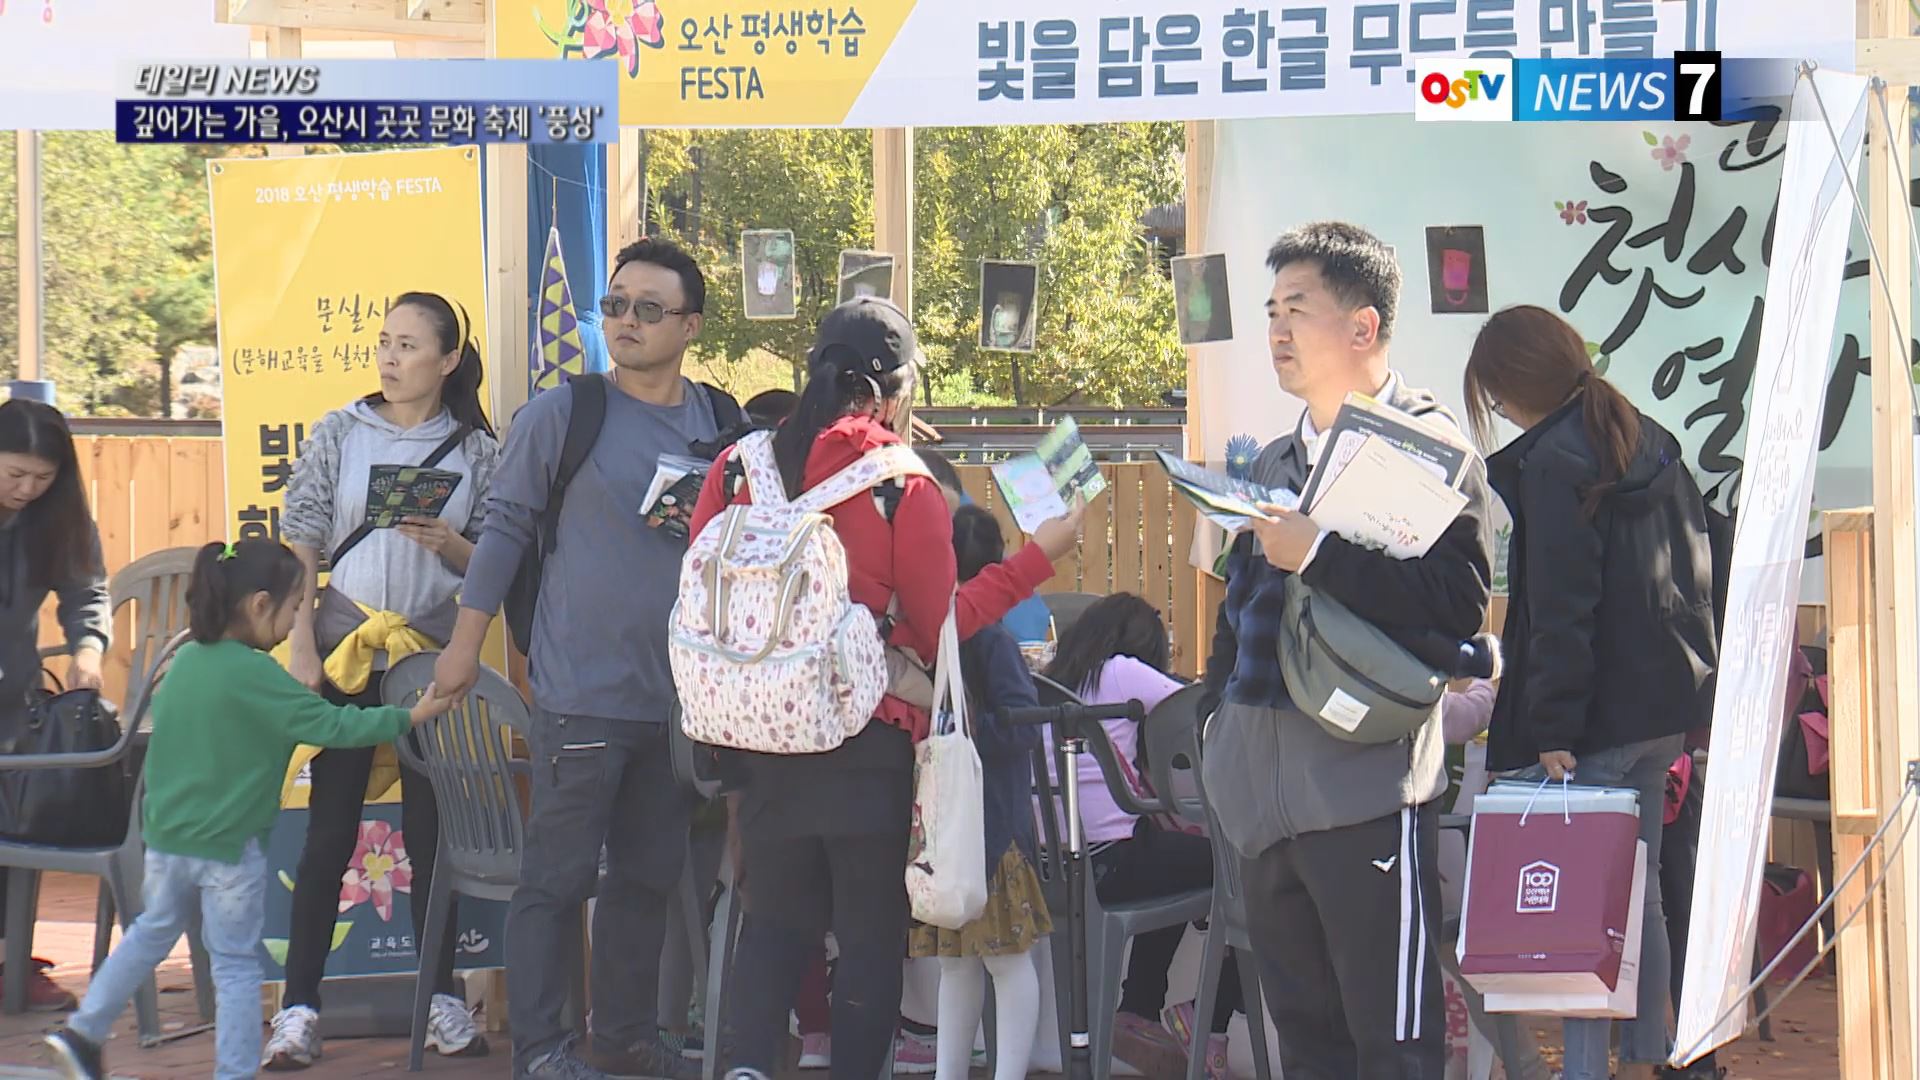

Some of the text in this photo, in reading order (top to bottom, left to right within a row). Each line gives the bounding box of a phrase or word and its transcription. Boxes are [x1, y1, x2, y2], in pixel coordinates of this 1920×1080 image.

[678, 7, 866, 57] 오산 평생학습
[978, 19, 1079, 100] 빛을
[1098, 14, 1202, 98] 담은
[1222, 7, 1329, 93] 한글
[681, 66, 765, 100] FESTA
[255, 176, 443, 204] 2018 오산 평생학습 FESTA
[332, 343, 378, 373] 실천
[259, 422, 305, 493] 빛
[1524, 872, 1553, 887] 100
[369, 928, 490, 954] 교육도 산
